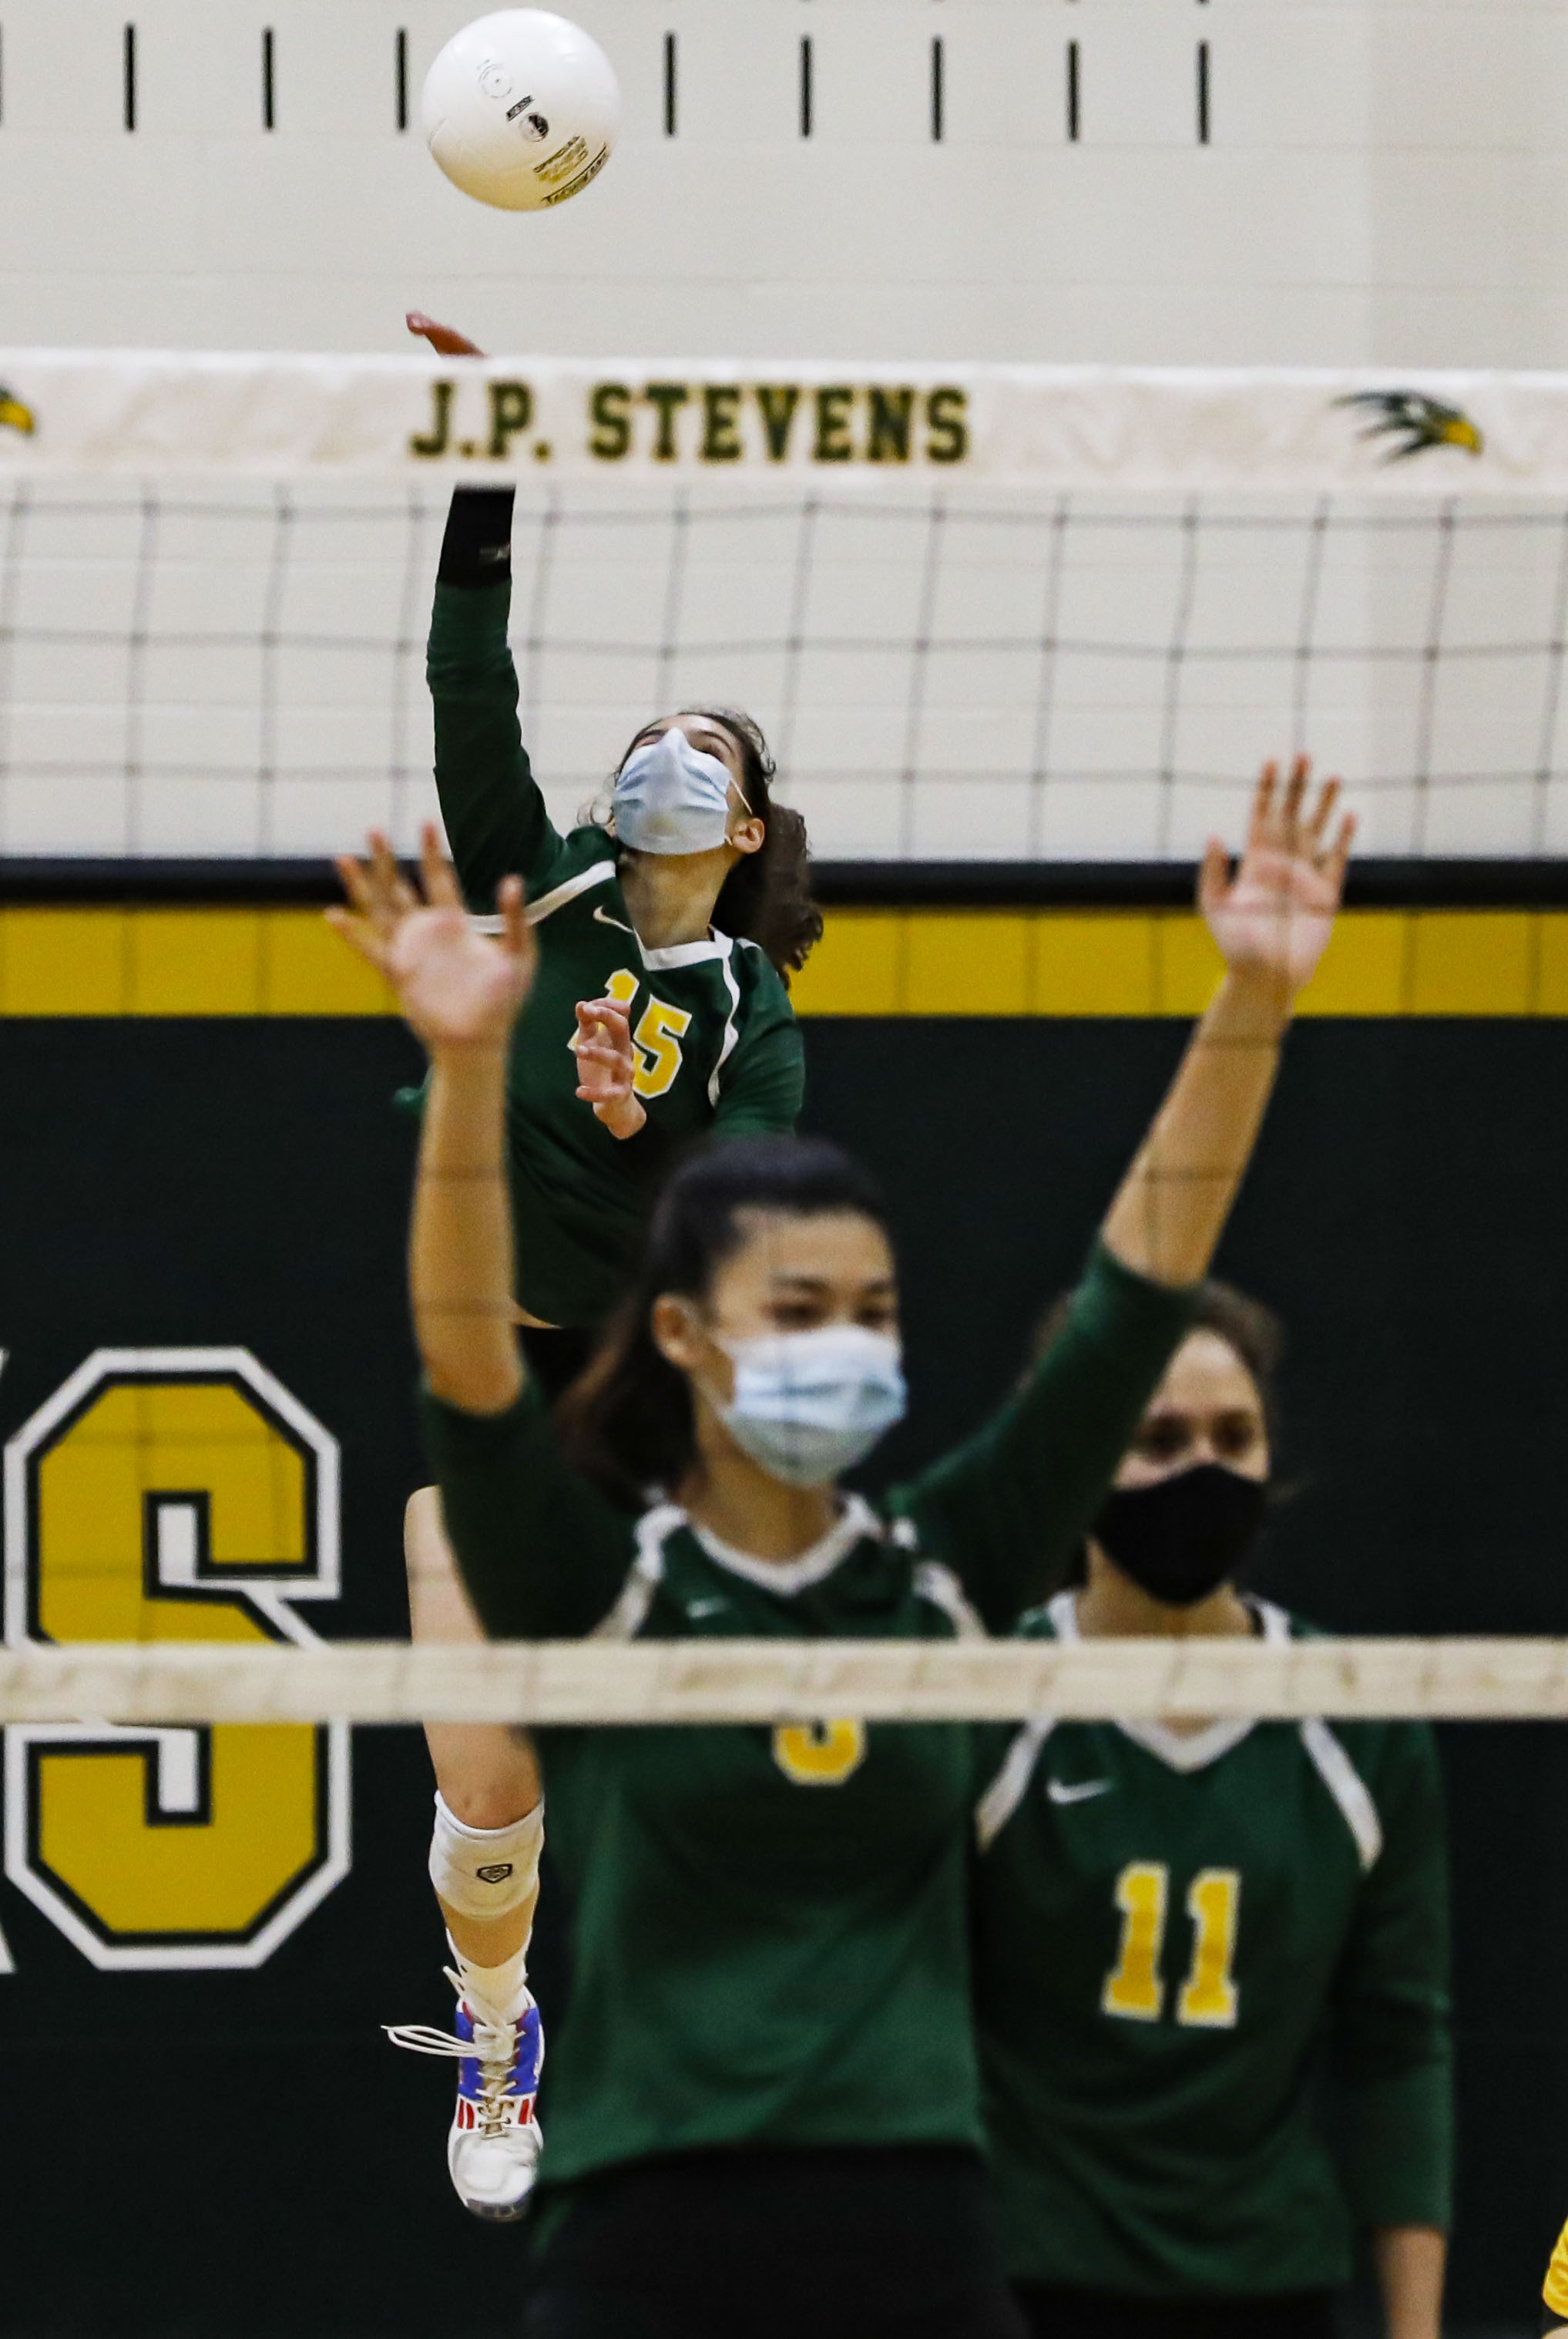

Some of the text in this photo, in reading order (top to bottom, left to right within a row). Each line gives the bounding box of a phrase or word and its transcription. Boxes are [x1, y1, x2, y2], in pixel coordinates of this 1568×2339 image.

[409, 378, 969, 464] J.P. STEVENS
[0, 1346, 351, 1971] S
[1101, 1860, 1240, 2029] 11
